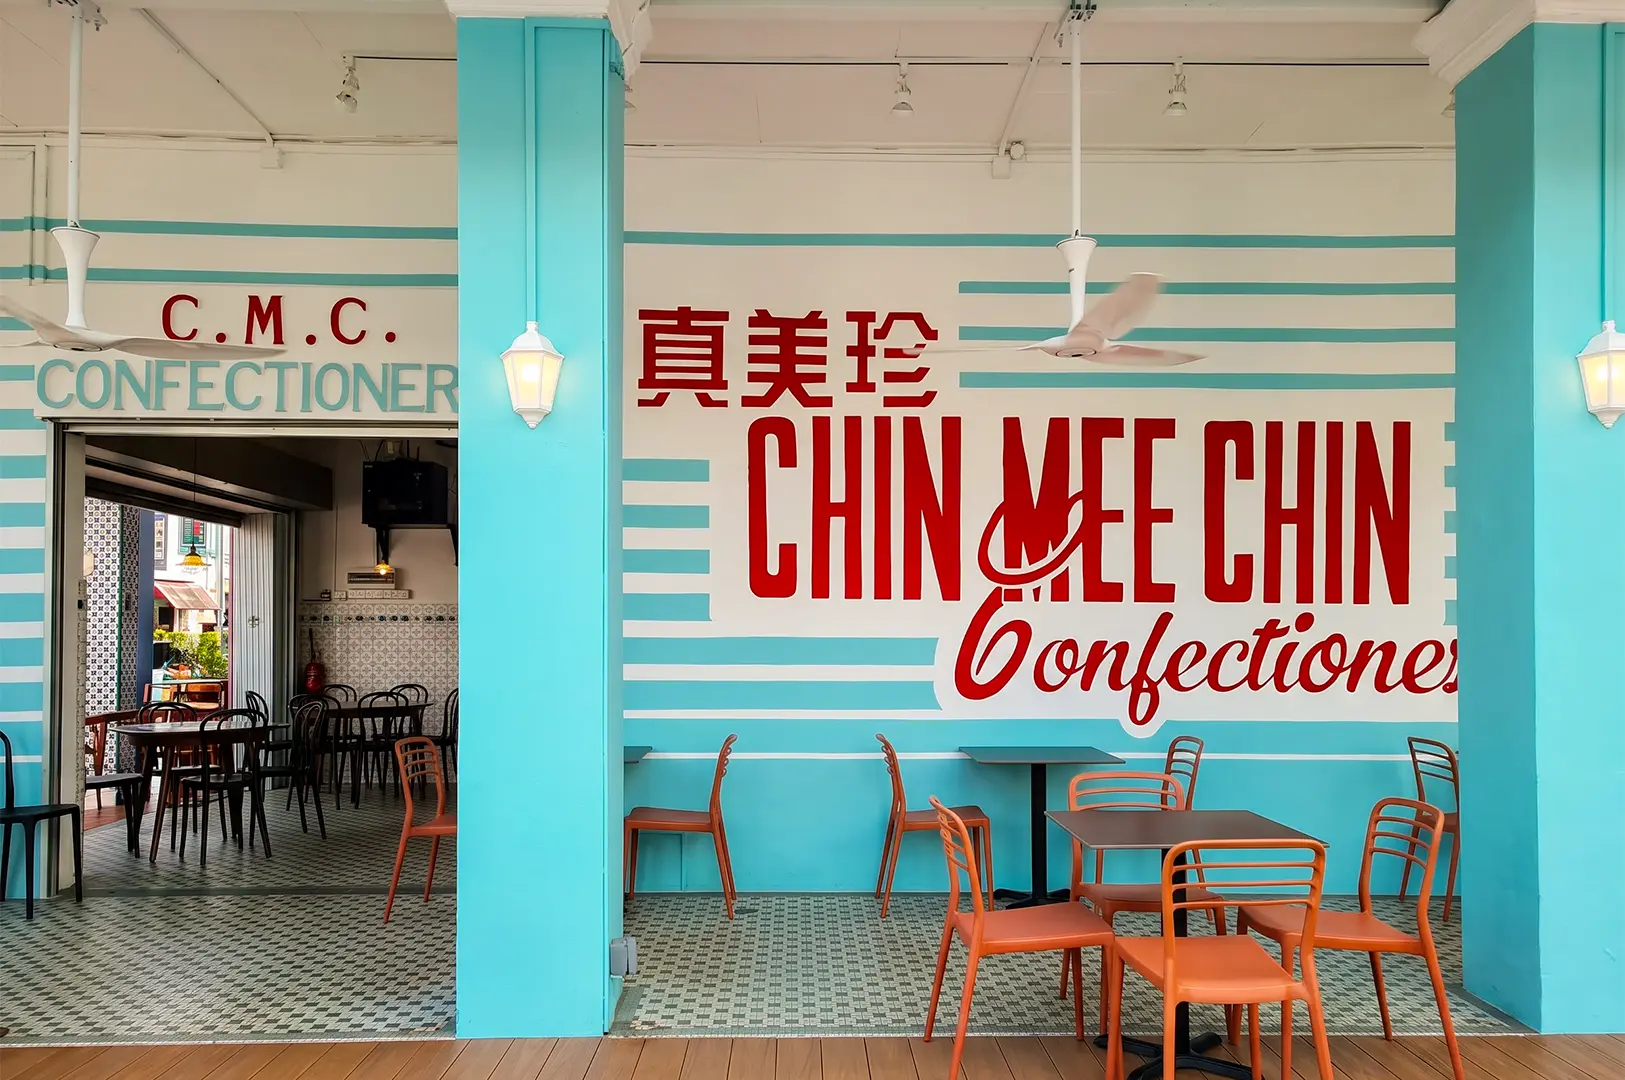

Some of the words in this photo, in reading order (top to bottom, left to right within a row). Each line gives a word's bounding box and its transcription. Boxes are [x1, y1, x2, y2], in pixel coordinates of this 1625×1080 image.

[162, 294, 397, 345] C.M.C.
[638, 306, 939, 408] 真美珍
[37, 358, 458, 413] CONFECTIONER
[748, 416, 962, 602] CHIN
[1002, 417, 1176, 603] MEE
[1204, 420, 1411, 605] CHIN
